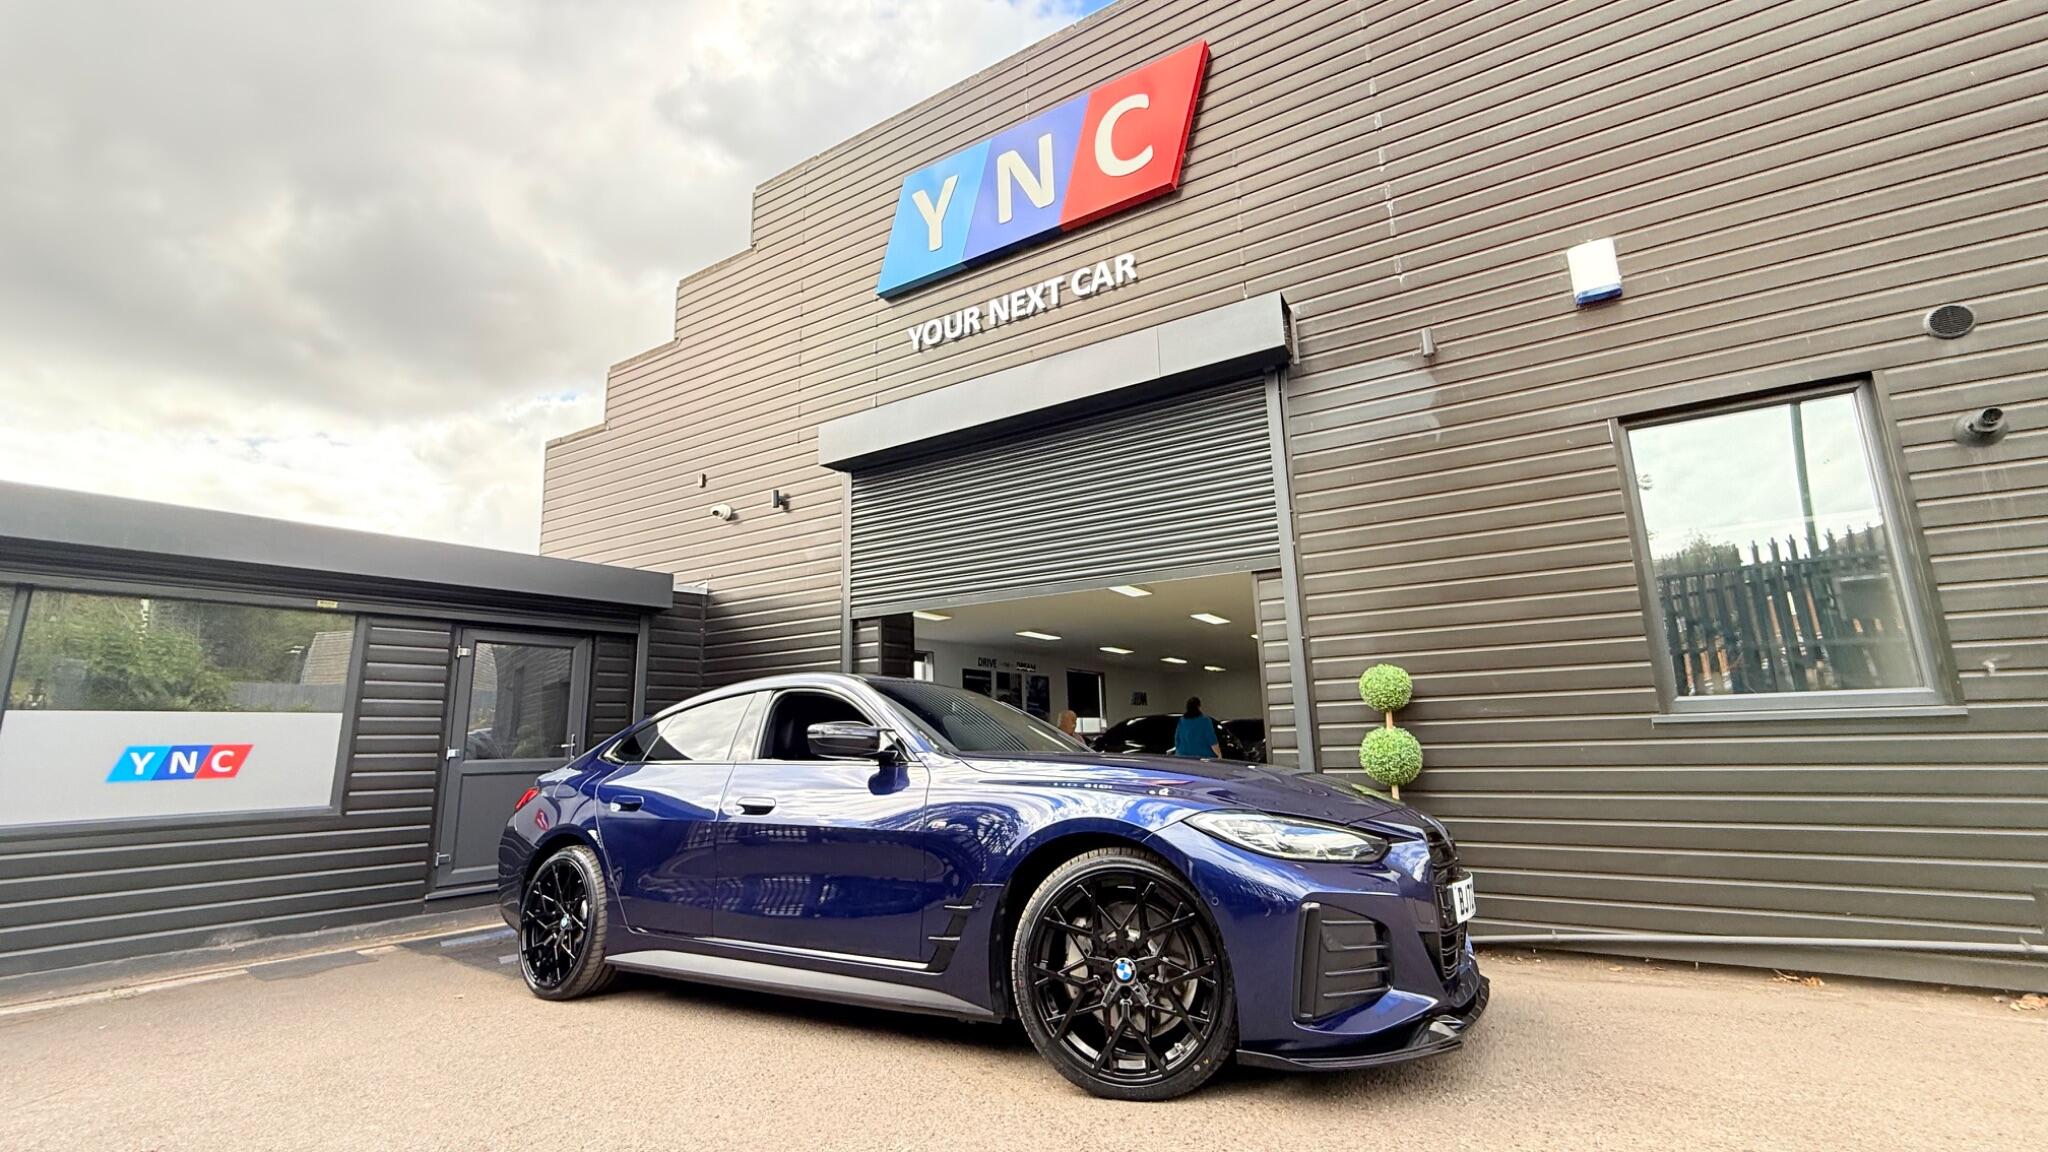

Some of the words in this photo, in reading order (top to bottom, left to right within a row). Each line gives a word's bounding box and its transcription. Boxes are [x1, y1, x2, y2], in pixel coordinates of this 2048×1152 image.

[911, 93, 1153, 252] YNC
[907, 306, 982, 350] YOUR
[989, 276, 1064, 325] NEXT
[1071, 253, 1137, 297] CAR
[130, 750, 235, 776] YNC
